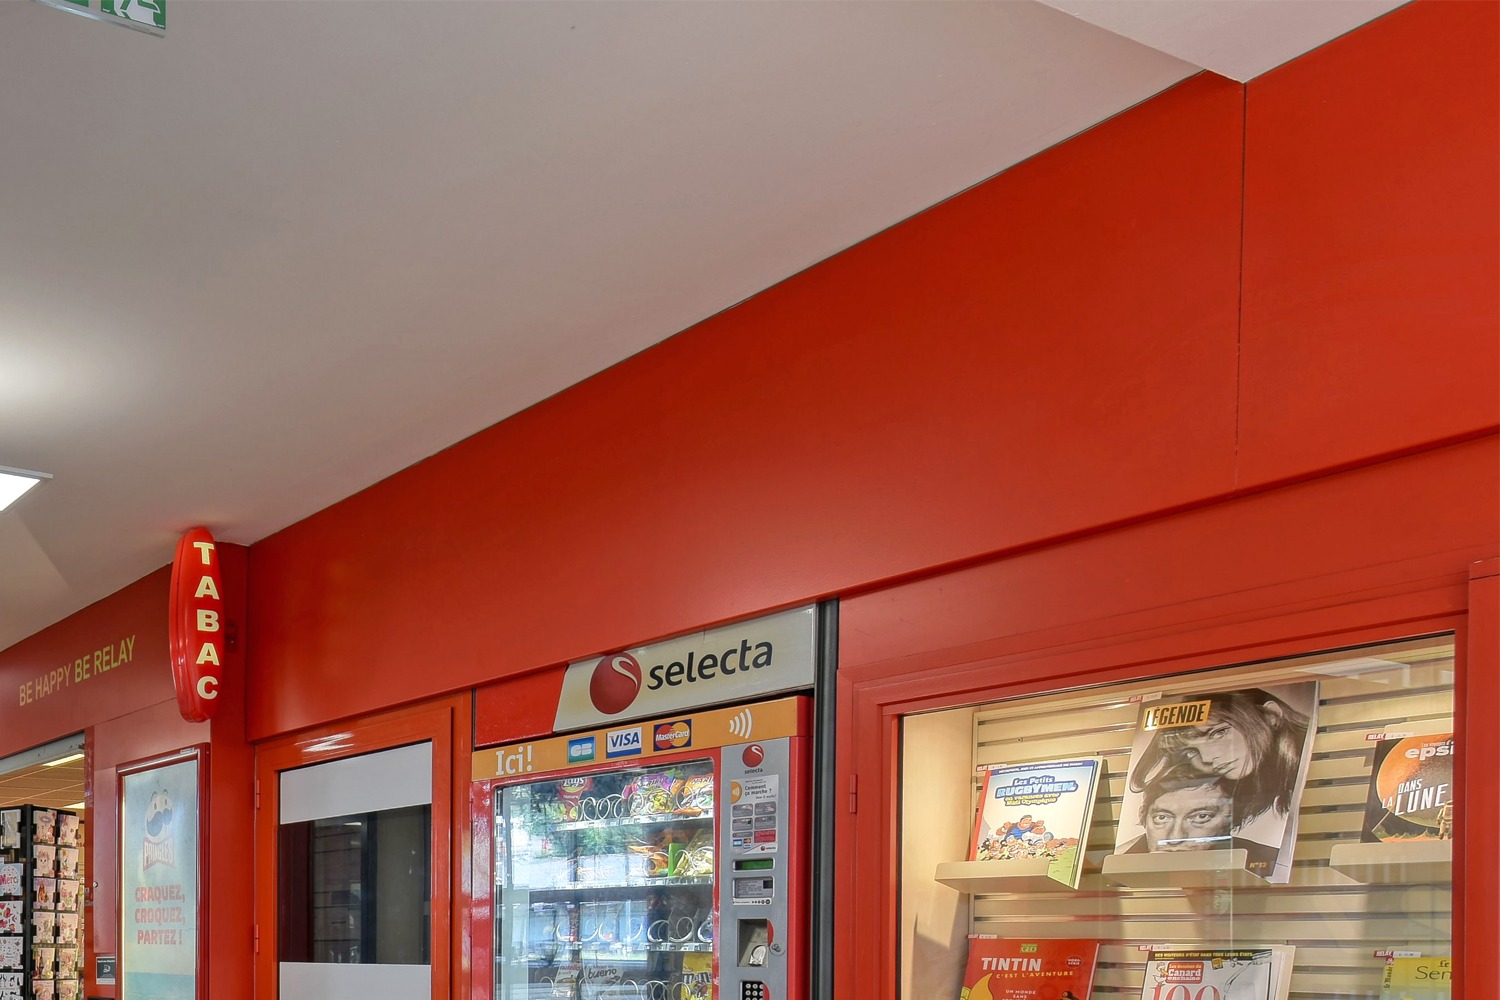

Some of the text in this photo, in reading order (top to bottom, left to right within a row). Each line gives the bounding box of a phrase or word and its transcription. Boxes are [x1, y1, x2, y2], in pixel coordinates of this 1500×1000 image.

[193, 541, 220, 700] TABAC
[19, 635, 136, 707] BE HAPPY BE RELAY
[647, 638, 774, 691] selecta
[1144, 702, 1204, 728] LÉGENDE
[609, 732, 640, 749] VISA
[655, 729, 690, 743] MasterCard
[1030, 776, 1053, 784] Petits
[1398, 779, 1423, 794] DANS
[1382, 783, 1449, 816] LA LUNE
[143, 838, 174, 868] PRINGLES
[135, 884, 186, 905] CRAQUEZ,
[134, 906, 186, 927] CROQUEZ,
[137, 929, 177, 945] PARTEZ
[981, 957, 1042, 972] TINTIN
[1167, 968, 1201, 977] Canard
[588, 968, 617, 979] bueno
[1022, 970, 1074, 978] L'AVENTURE
